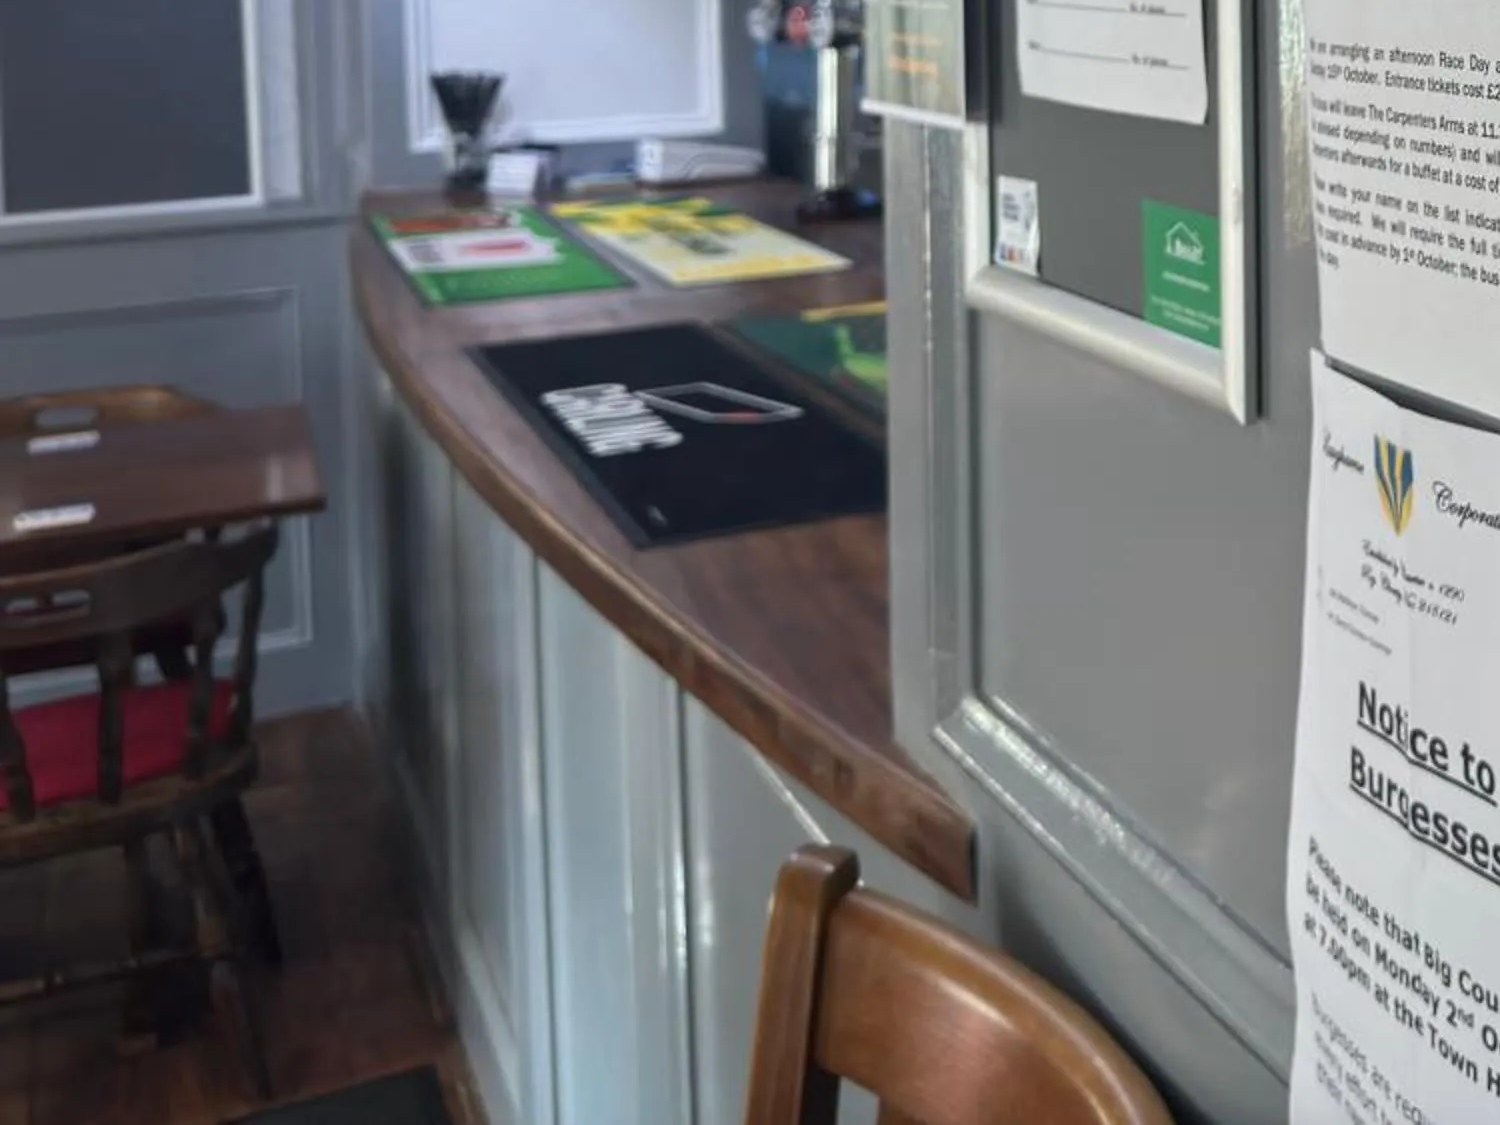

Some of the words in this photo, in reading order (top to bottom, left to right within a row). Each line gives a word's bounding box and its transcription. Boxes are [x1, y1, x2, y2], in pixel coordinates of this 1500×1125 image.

[1389, 47, 1434, 66] afternoon
[1439, 51, 1464, 70] Race
[1469, 54, 1490, 75] Day
[1385, 70, 1425, 91] Entrance
[1427, 76, 1461, 96] tickets
[1462, 83, 1484, 99] cost
[1439, 114, 1465, 134] Arms
[1461, 146, 1480, 164] and
[1465, 174, 1486, 192] cost
[1488, 177, 1500, 193] of
[1480, 266, 1500, 287] bus
[1358, 680, 1449, 772] Notice
[1460, 741, 1496, 796] to
[1345, 884, 1380, 927] note
[1383, 911, 1420, 956] that
[1424, 942, 1452, 989] Big
[1351, 926, 1371, 956] on
[1374, 941, 1440, 1017] Monday
[1446, 998, 1475, 1029] 2nd
[1374, 982, 1390, 1013] at
[1394, 997, 1424, 1037] the
[1428, 1022, 1479, 1084] Town
